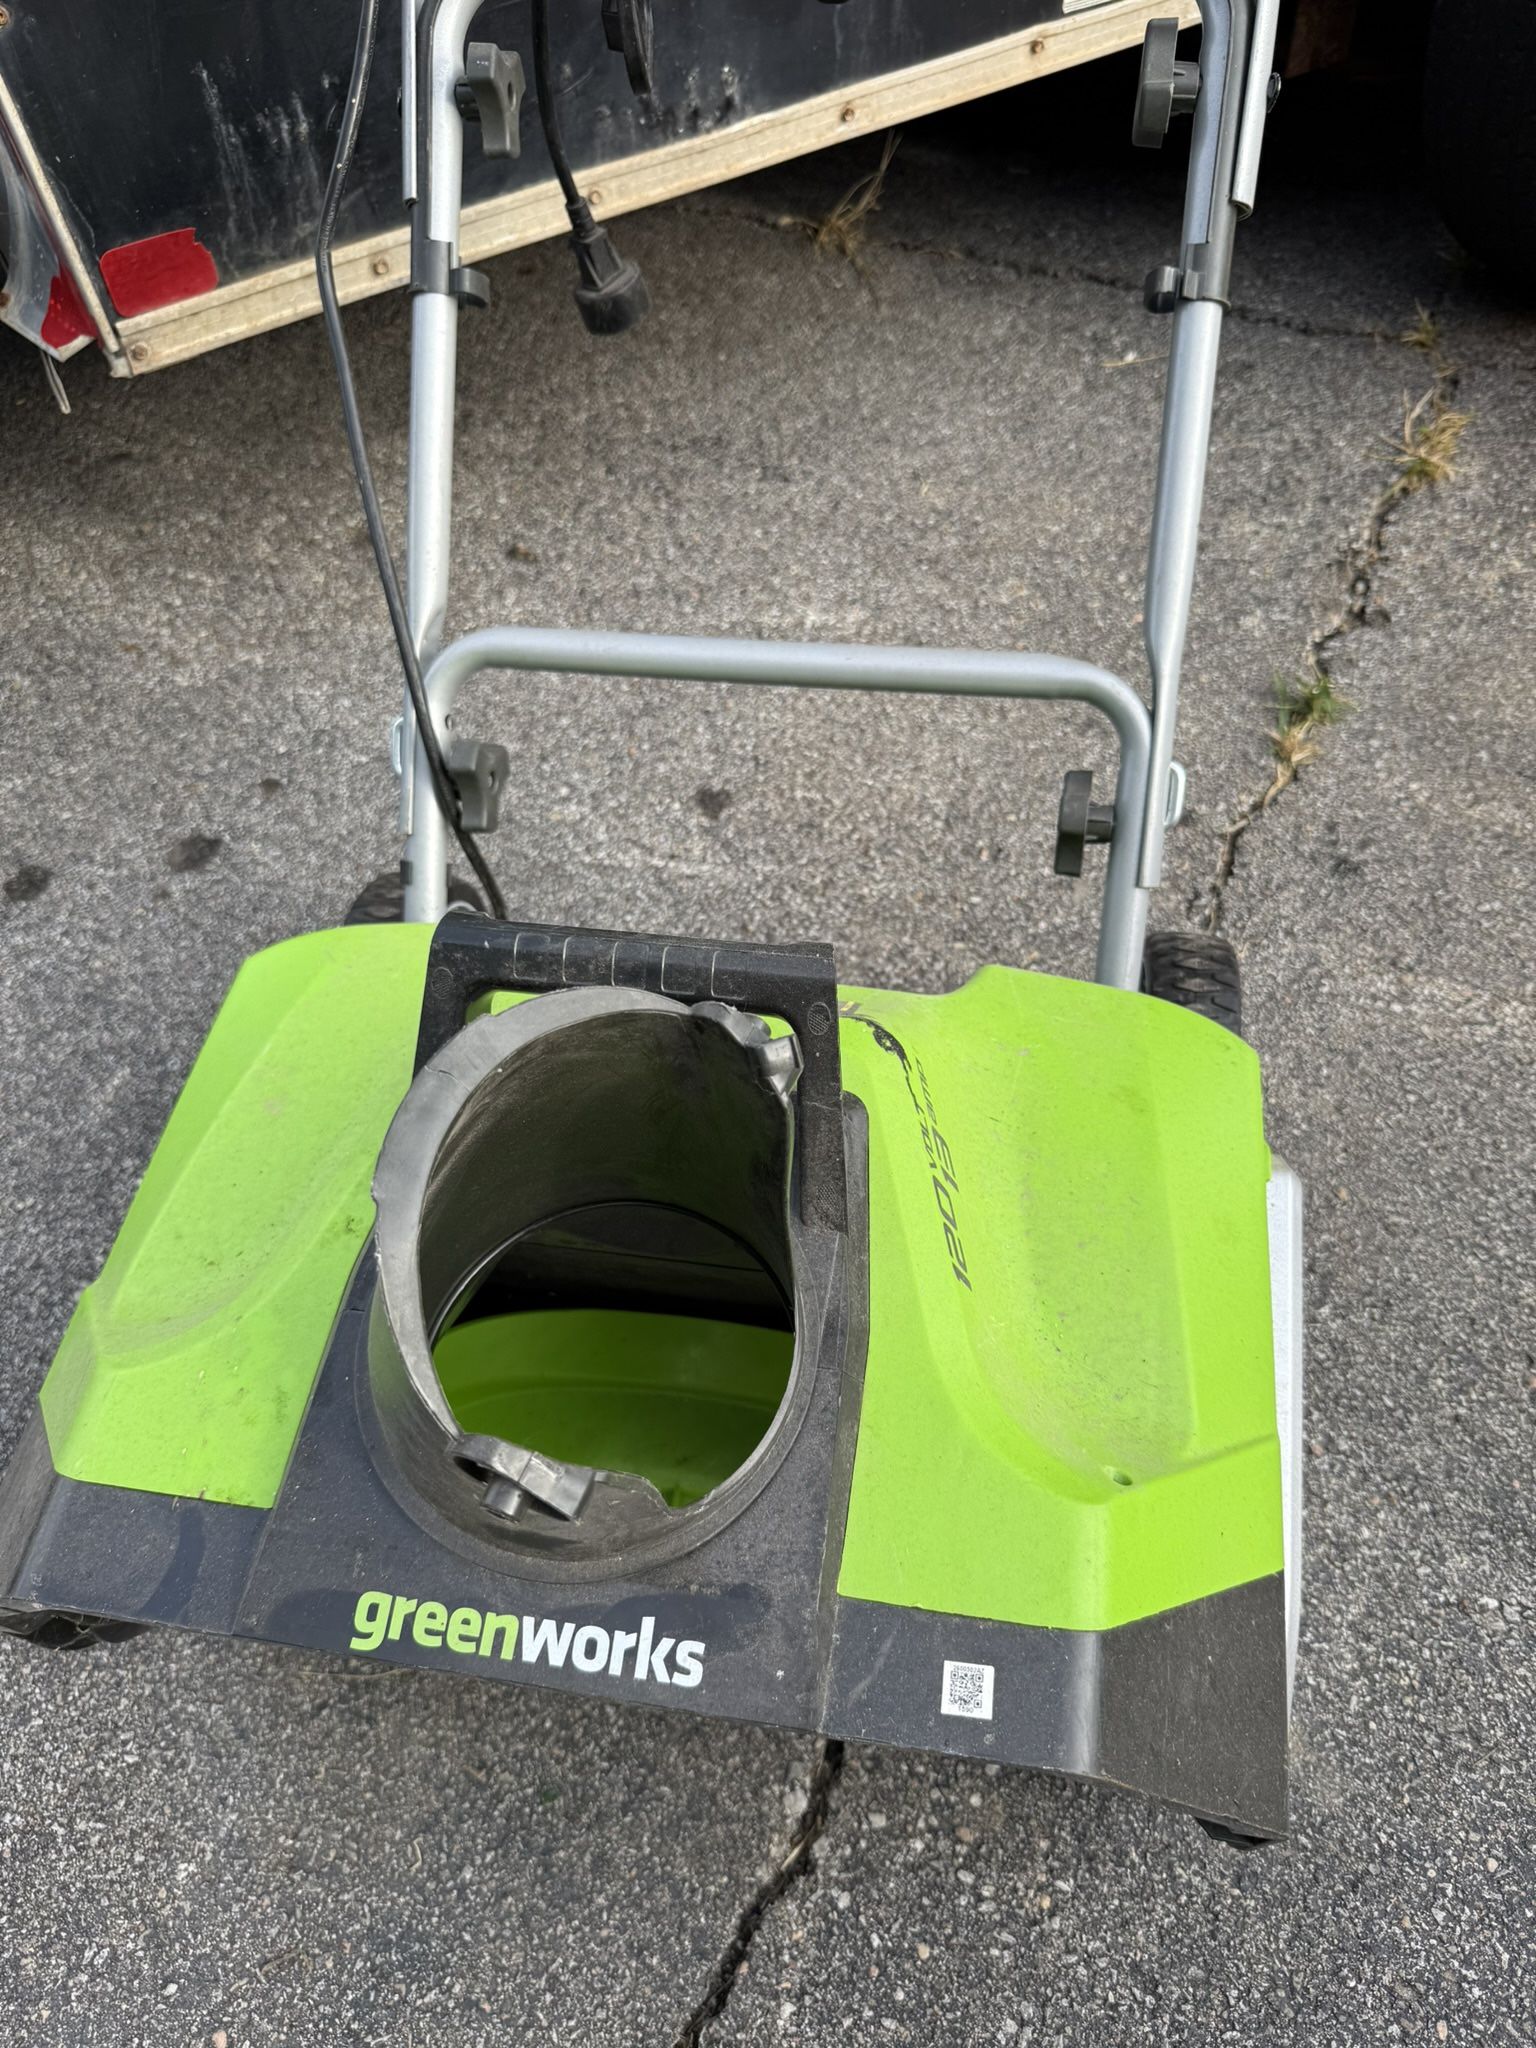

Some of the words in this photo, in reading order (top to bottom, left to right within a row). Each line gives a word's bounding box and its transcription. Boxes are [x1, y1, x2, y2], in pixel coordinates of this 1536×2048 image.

[932, 1126, 959, 1192] 13
[932, 1175, 972, 1292] 120
[349, 1590, 706, 1688] greenworks
